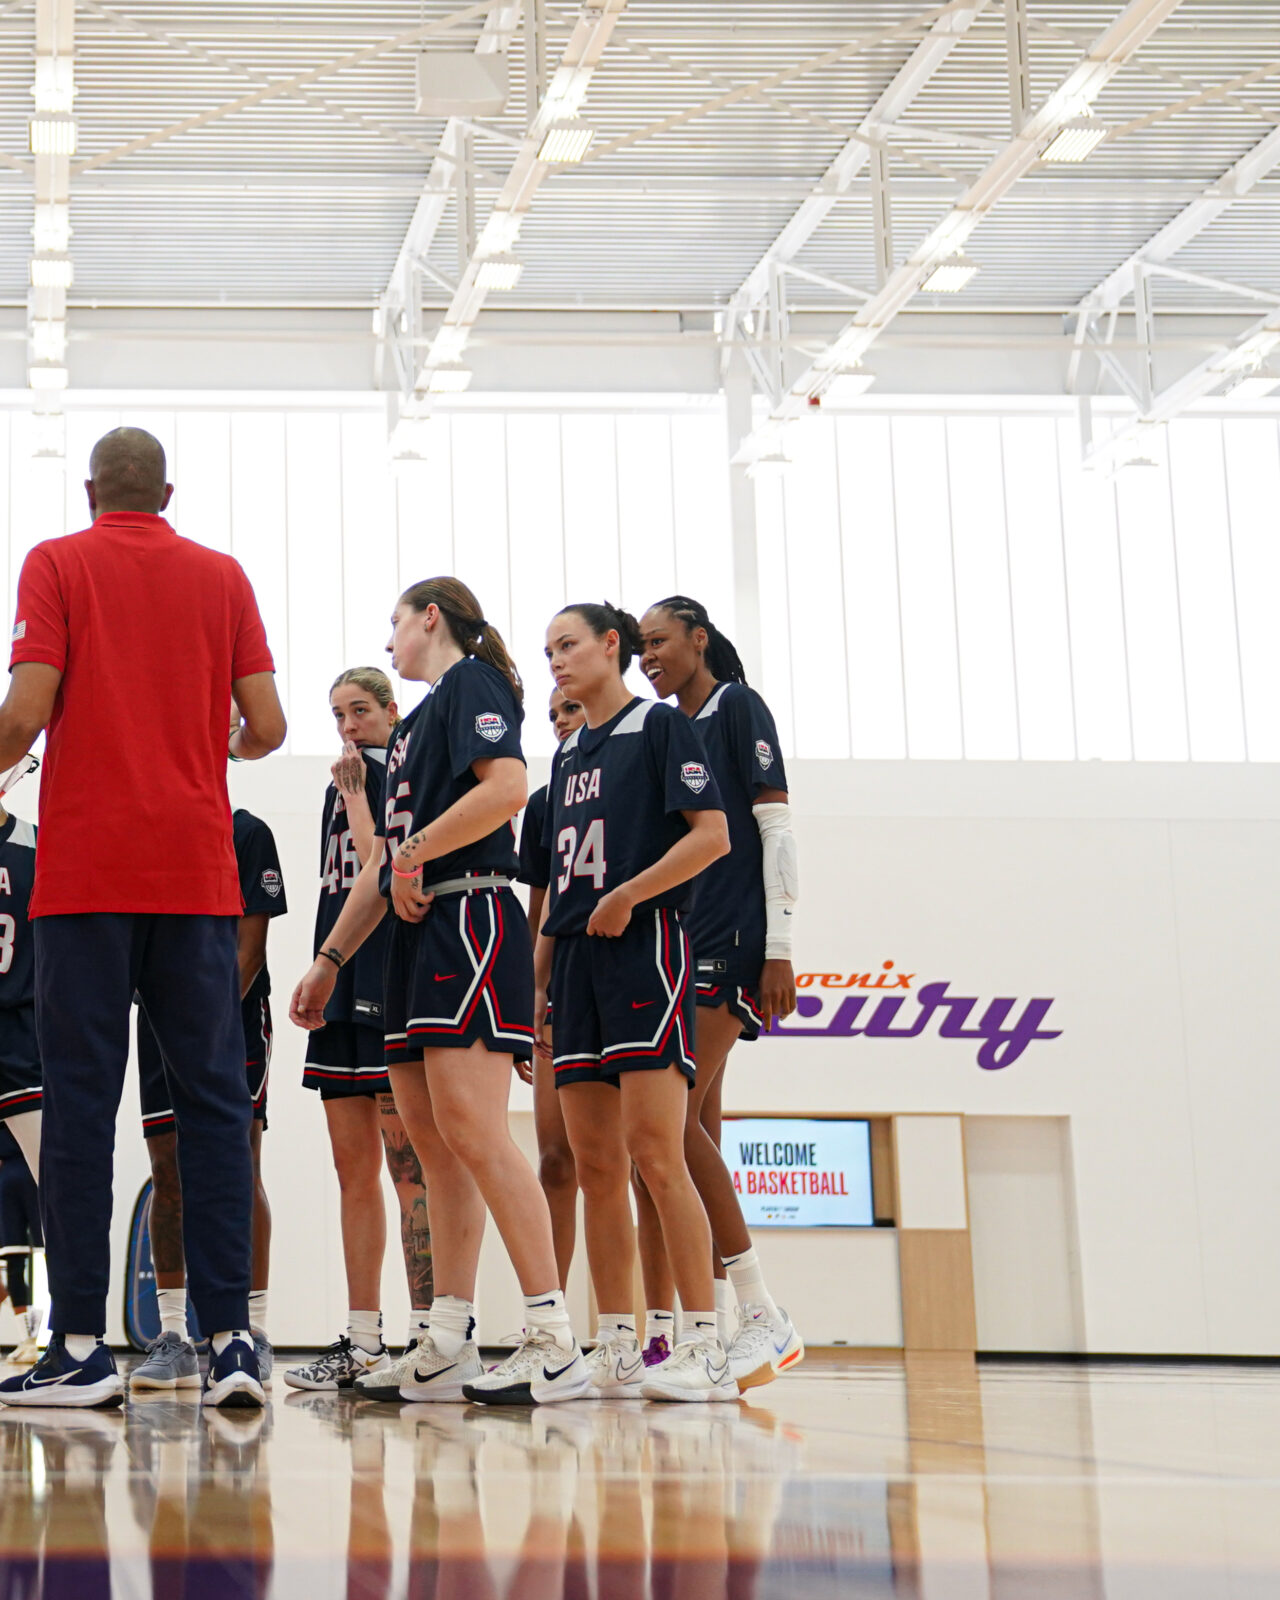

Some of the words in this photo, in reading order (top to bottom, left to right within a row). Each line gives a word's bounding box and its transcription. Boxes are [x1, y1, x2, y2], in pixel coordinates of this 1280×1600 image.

[564, 768, 601, 806] USA
[557, 819, 607, 894] 34
[795, 960, 916, 989] oenix
[739, 1142, 817, 1166] WELCOME
[747, 1171, 848, 1196] BASKETBALL
